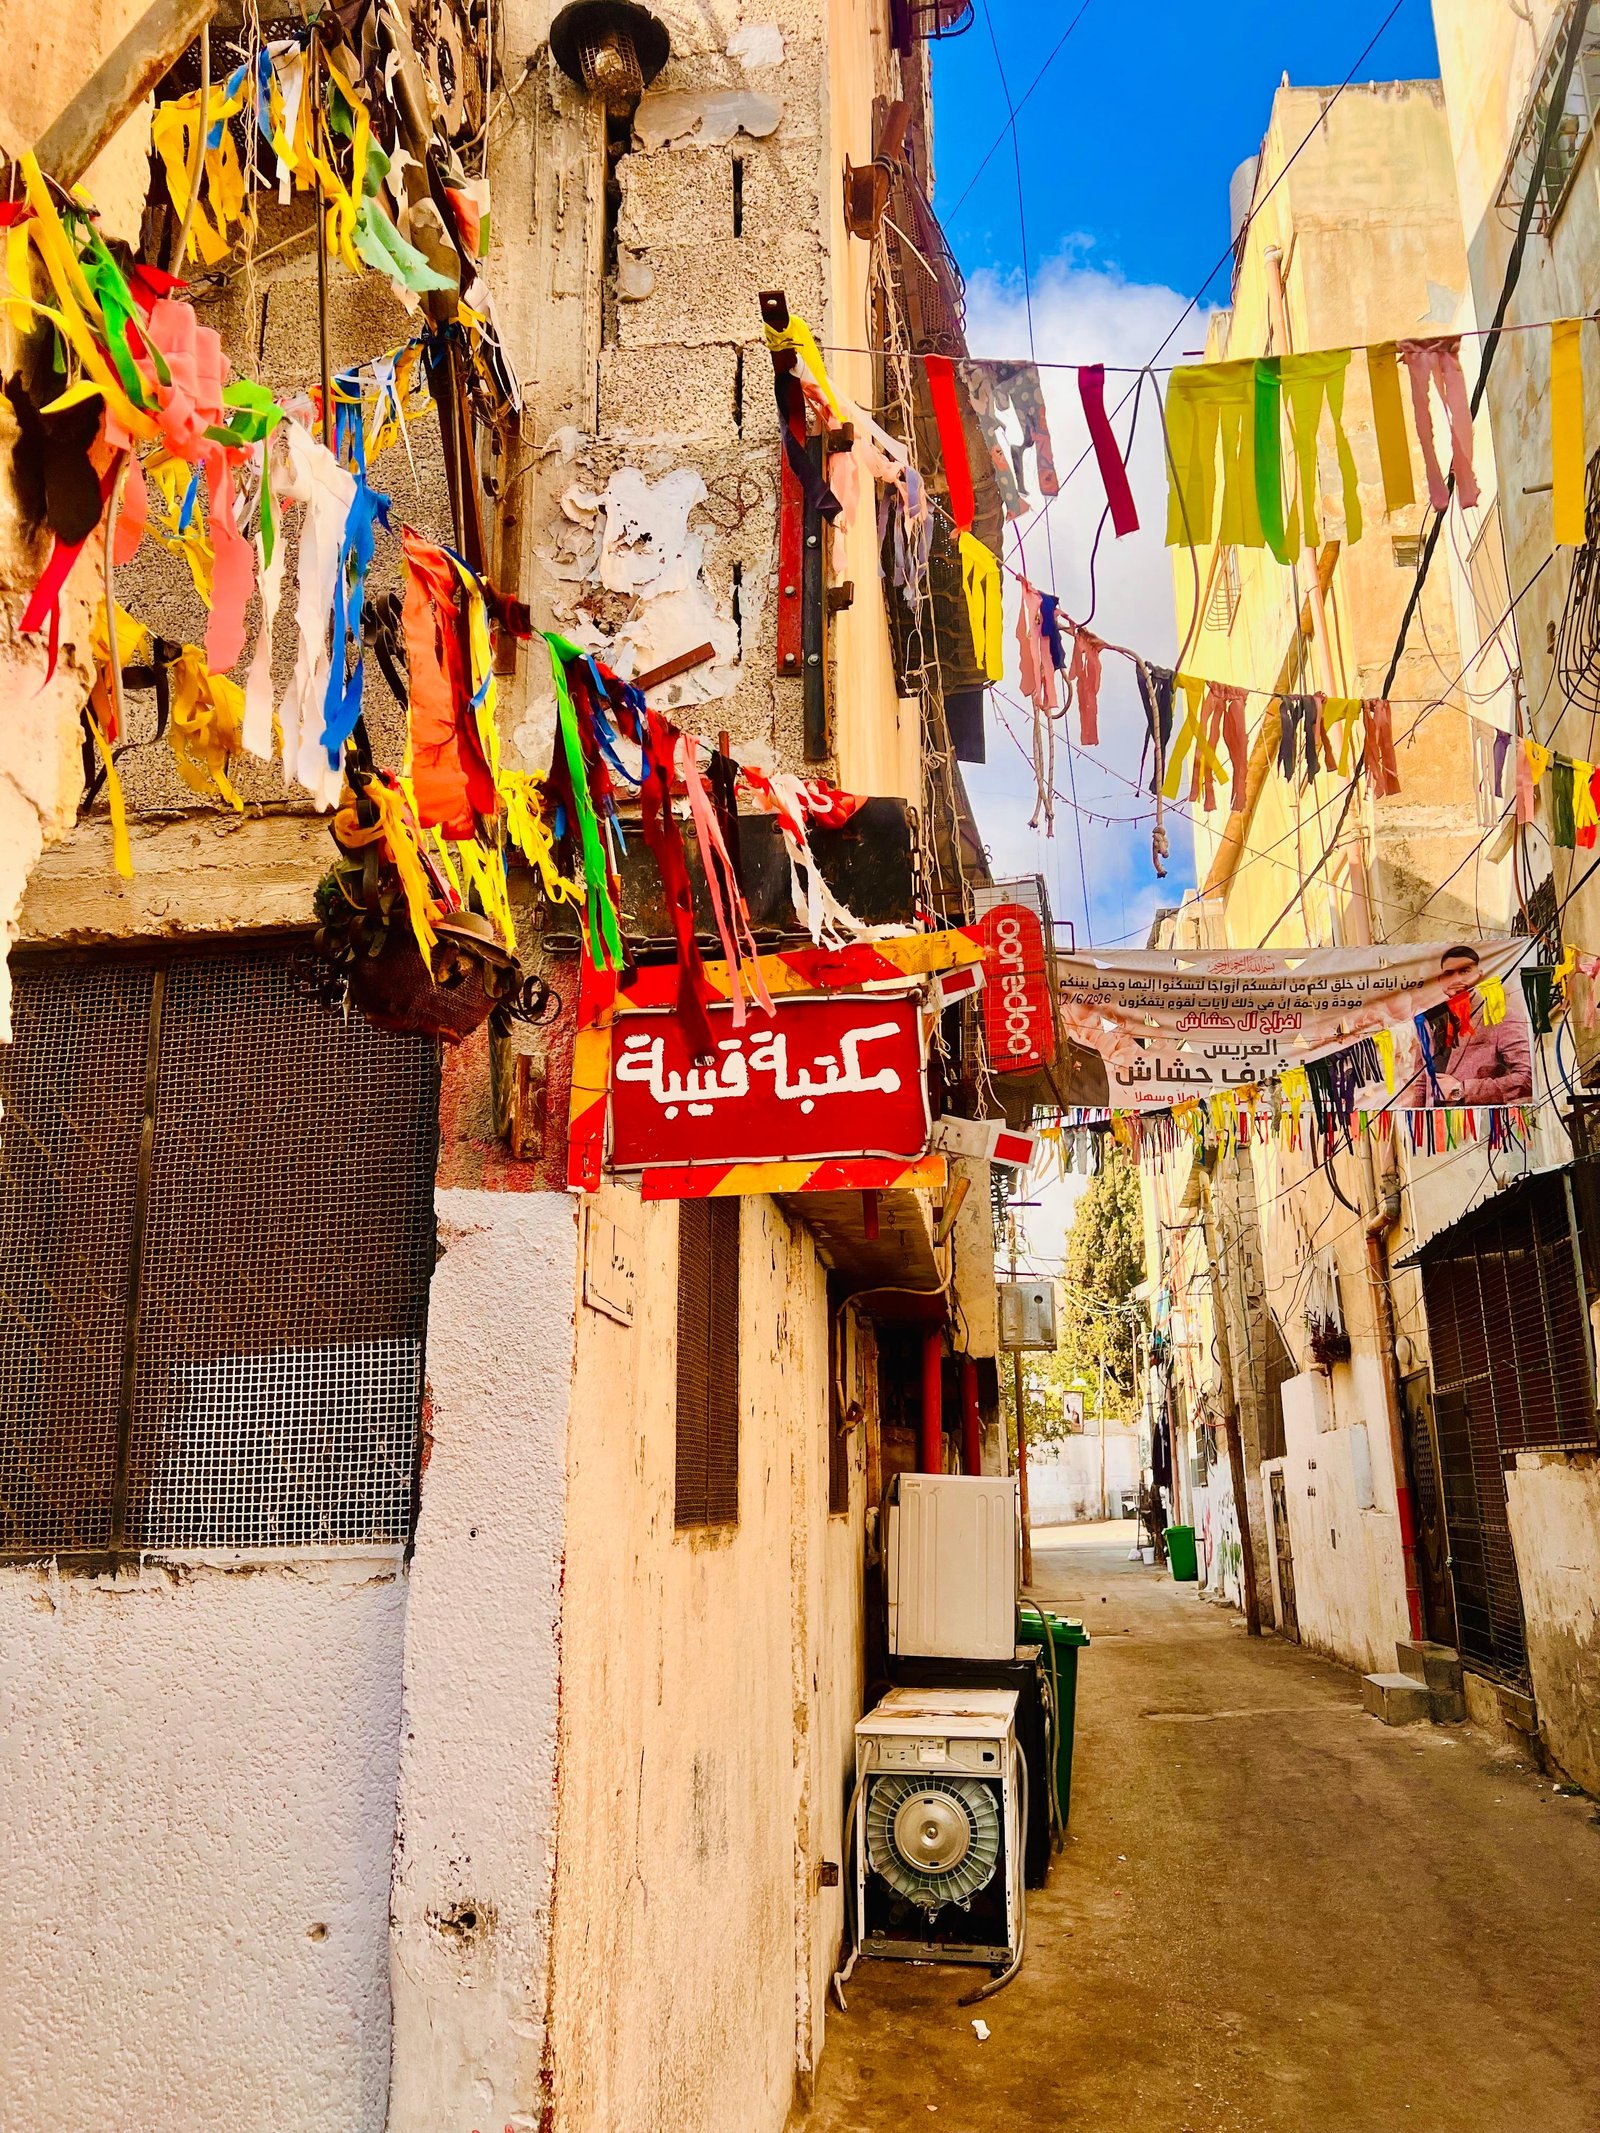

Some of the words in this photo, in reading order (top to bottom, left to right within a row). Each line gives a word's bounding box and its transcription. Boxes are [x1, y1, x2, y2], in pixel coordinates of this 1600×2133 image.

[996, 917, 1037, 1056] ooredoo
[1176, 1011, 1235, 1032] حشاش
[1203, 1039, 1278, 1060] العريس
[615, 1033, 750, 1119] قتيبة
[748, 1022, 902, 1114] مكتبة
[1115, 1057, 1213, 1086] حشاش
